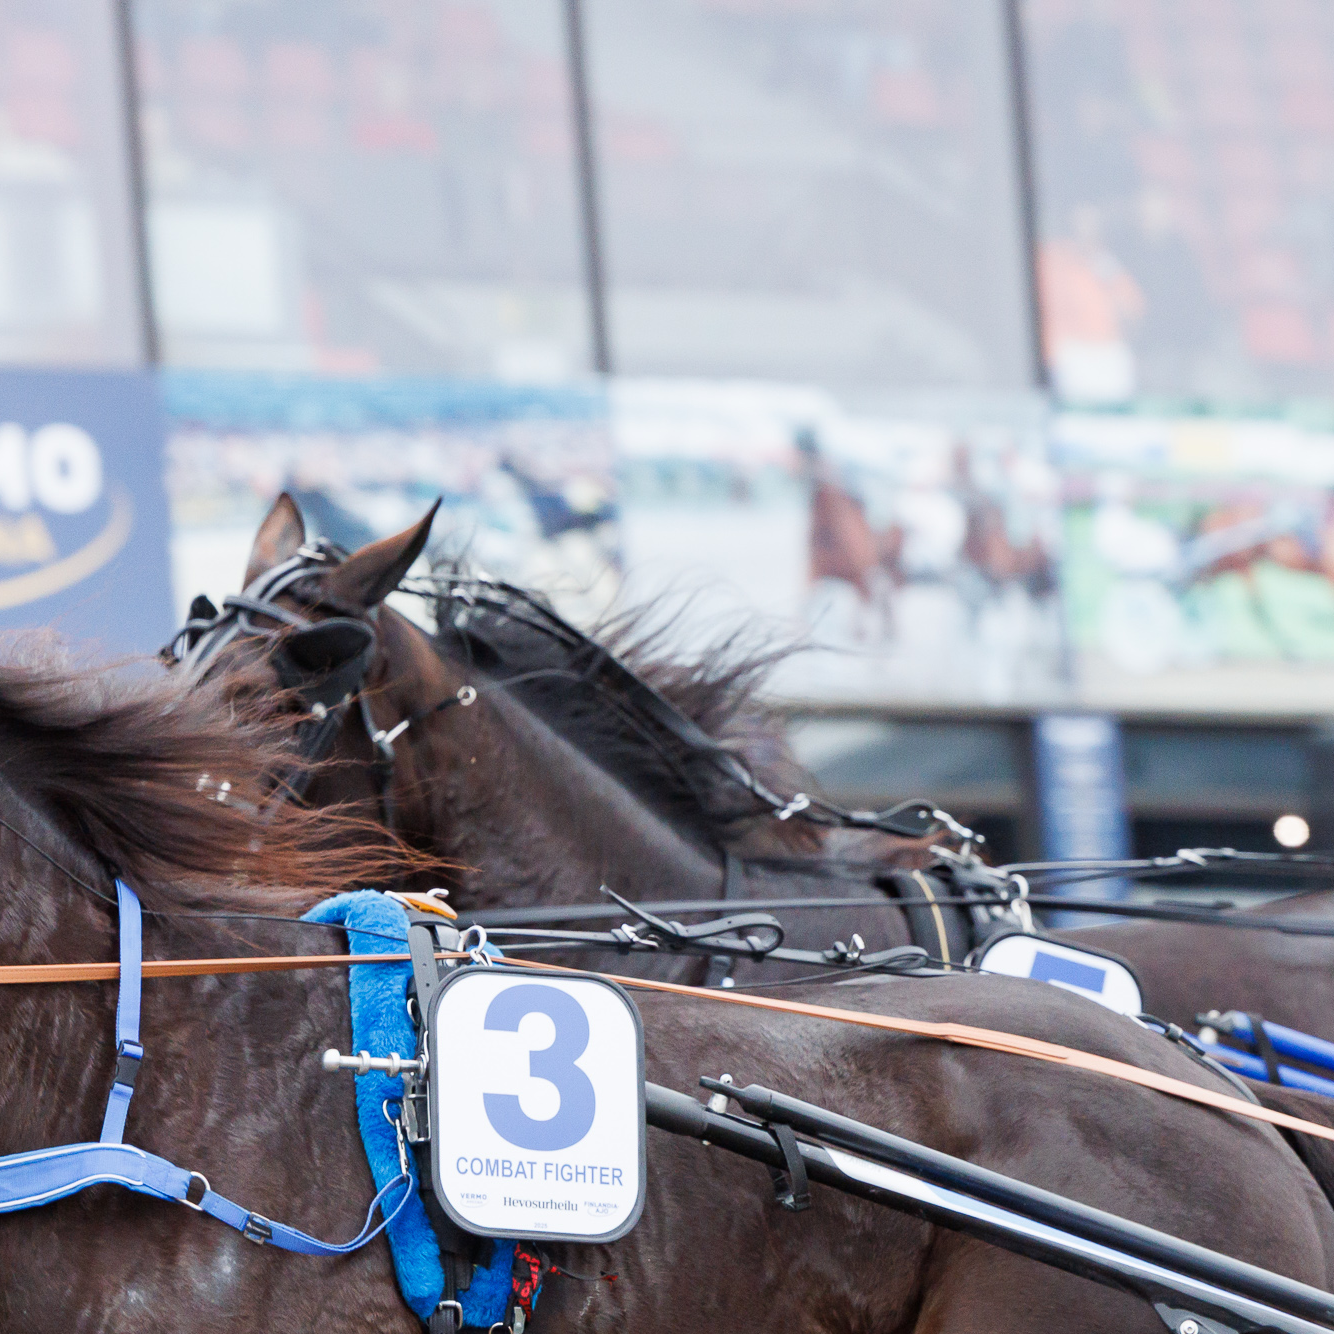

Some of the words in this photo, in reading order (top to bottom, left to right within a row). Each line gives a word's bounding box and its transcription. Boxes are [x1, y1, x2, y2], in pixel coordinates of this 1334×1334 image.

[482, 983, 597, 1152] 3
[456, 1156, 537, 1180] COMBAT
[544, 1162, 624, 1186] FIGHTER
[460, 1192, 487, 1200] VERMO
[503, 1196, 578, 1212] Hevosurheilu
